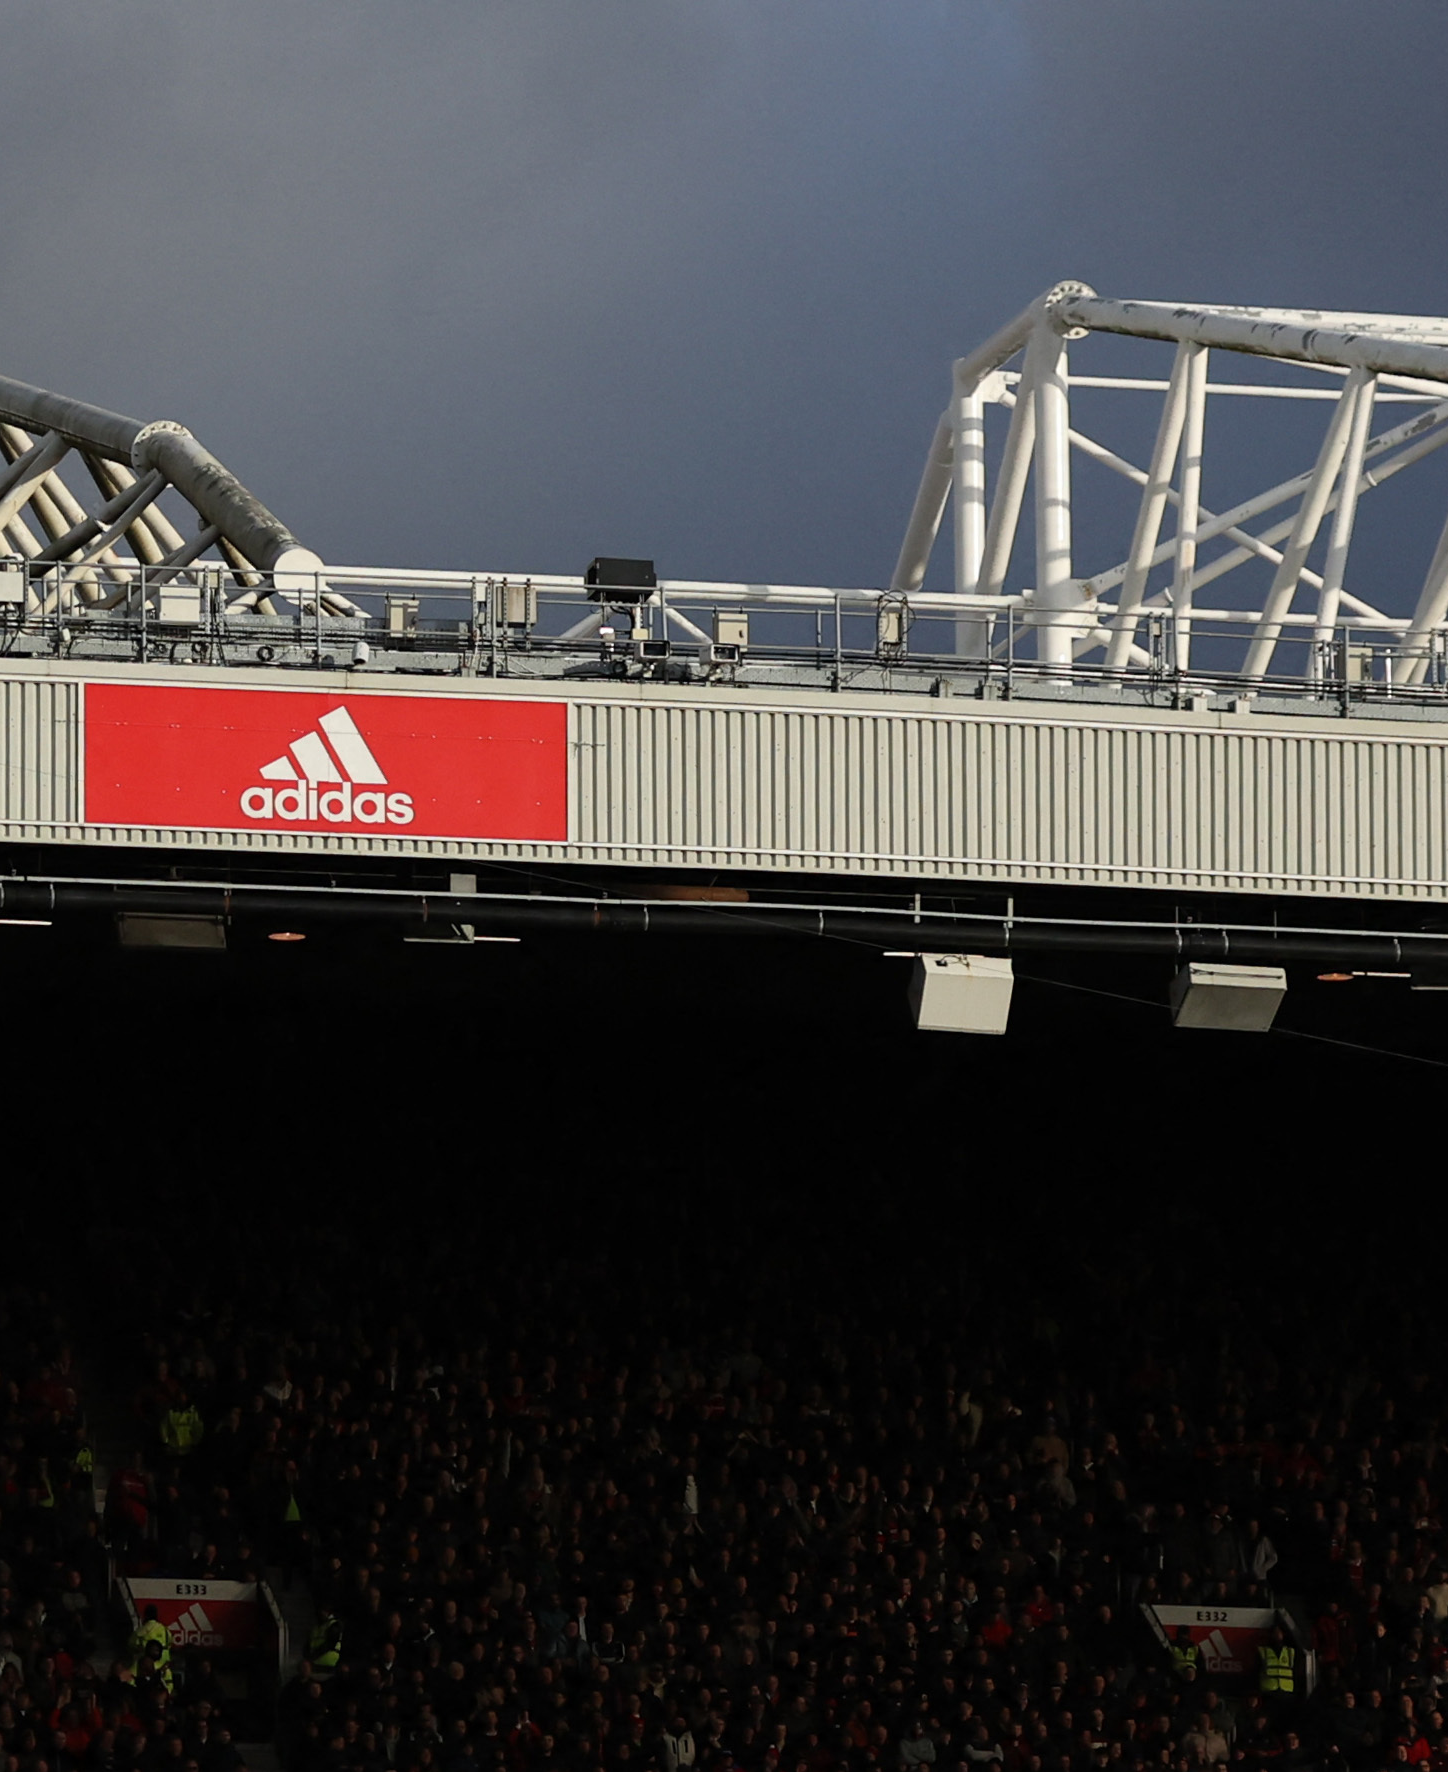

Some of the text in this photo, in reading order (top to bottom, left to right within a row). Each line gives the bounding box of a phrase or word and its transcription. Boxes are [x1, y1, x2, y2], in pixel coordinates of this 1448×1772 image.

[239, 779, 415, 824] adidas
[176, 1584, 207, 1595] E333
[1196, 1611, 1228, 1622] E332
[172, 1630, 224, 1647] didas
